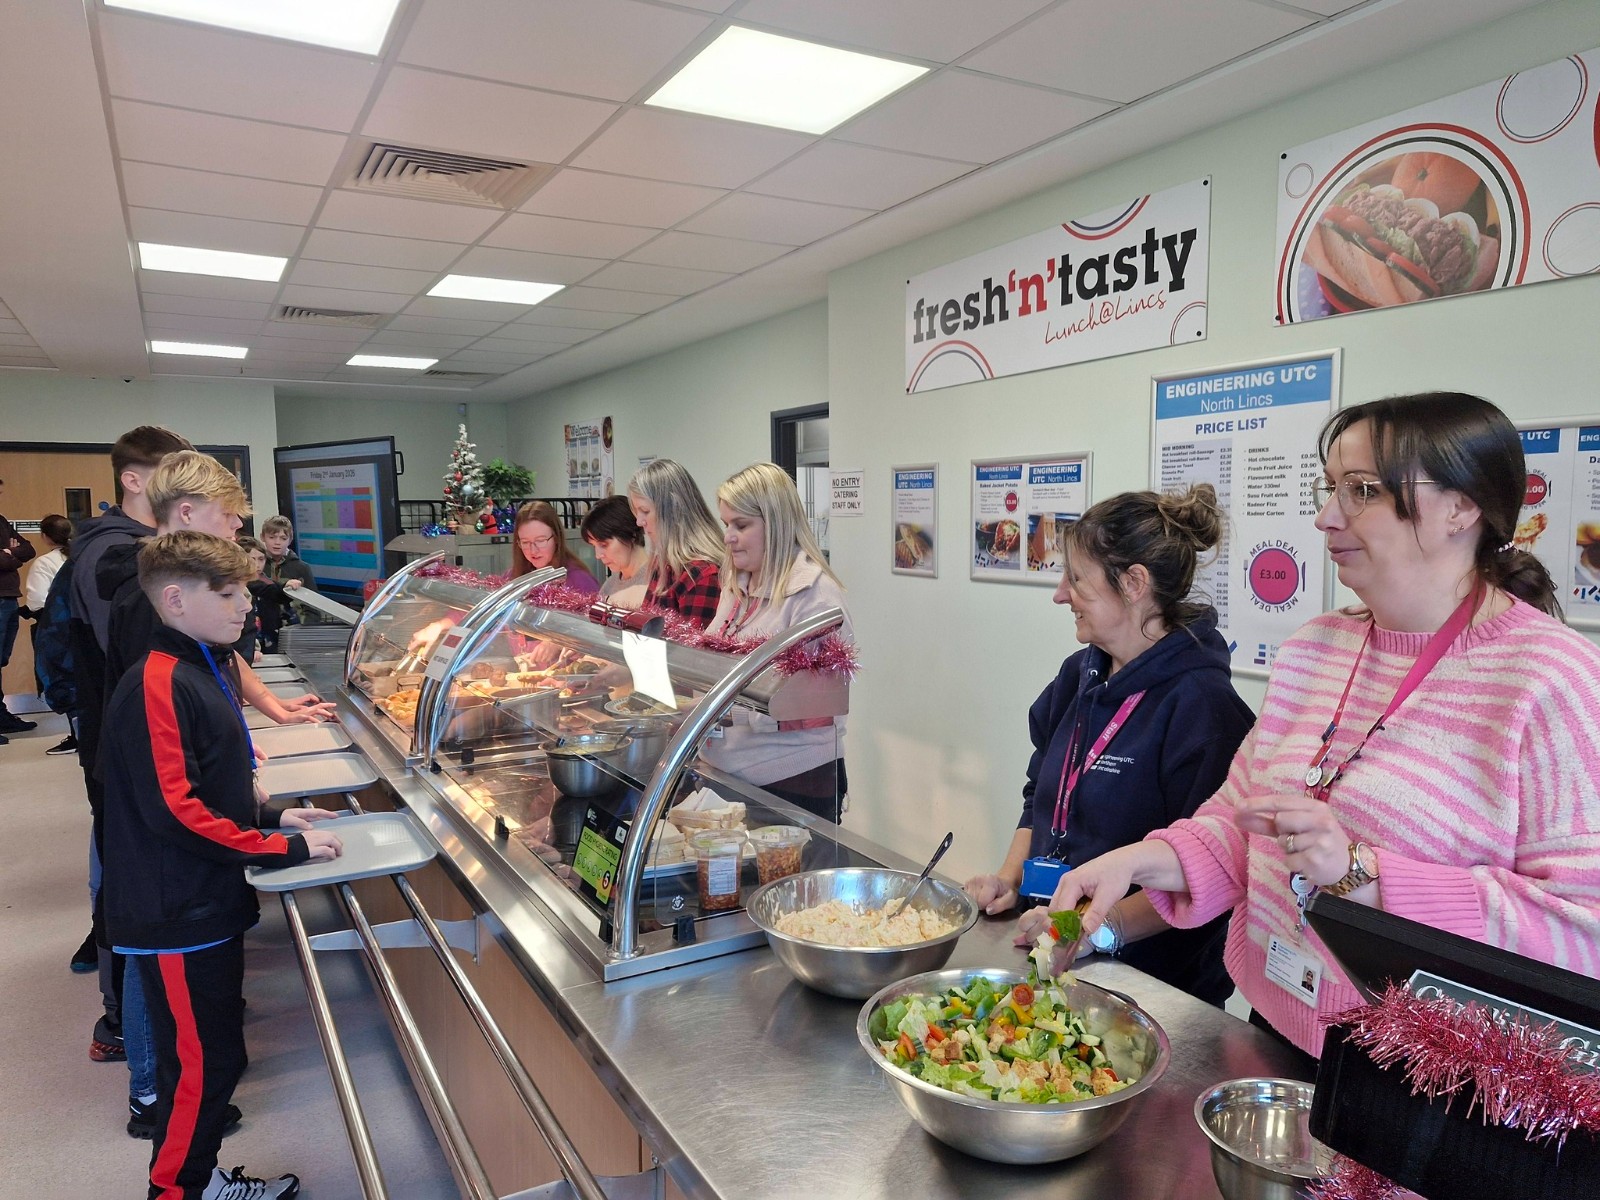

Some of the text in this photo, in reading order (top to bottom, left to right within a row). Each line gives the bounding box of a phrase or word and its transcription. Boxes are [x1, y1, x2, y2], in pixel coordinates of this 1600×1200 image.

[1045, 289, 1167, 344] Lunch@Lincs
[1166, 365, 1317, 399] ENGINEERING UTC
[1201, 393, 1273, 412] North Lincs
[1195, 417, 1267, 435] PRICE LIST
[1527, 431, 1551, 440] UTC
[1033, 466, 1077, 474] ENGINEERING
[832, 477, 860, 486] NO ENTRY
[898, 472, 932, 480] ENGINEERING
[1032, 475, 1045, 483] UTC
[832, 501, 861, 509] STAFF ONLY
[1249, 539, 1273, 558] MEAL
[1275, 539, 1299, 559] DEAL
[1260, 569, 1286, 580] £3.00
[1250, 593, 1299, 613] MEAL DEAL
